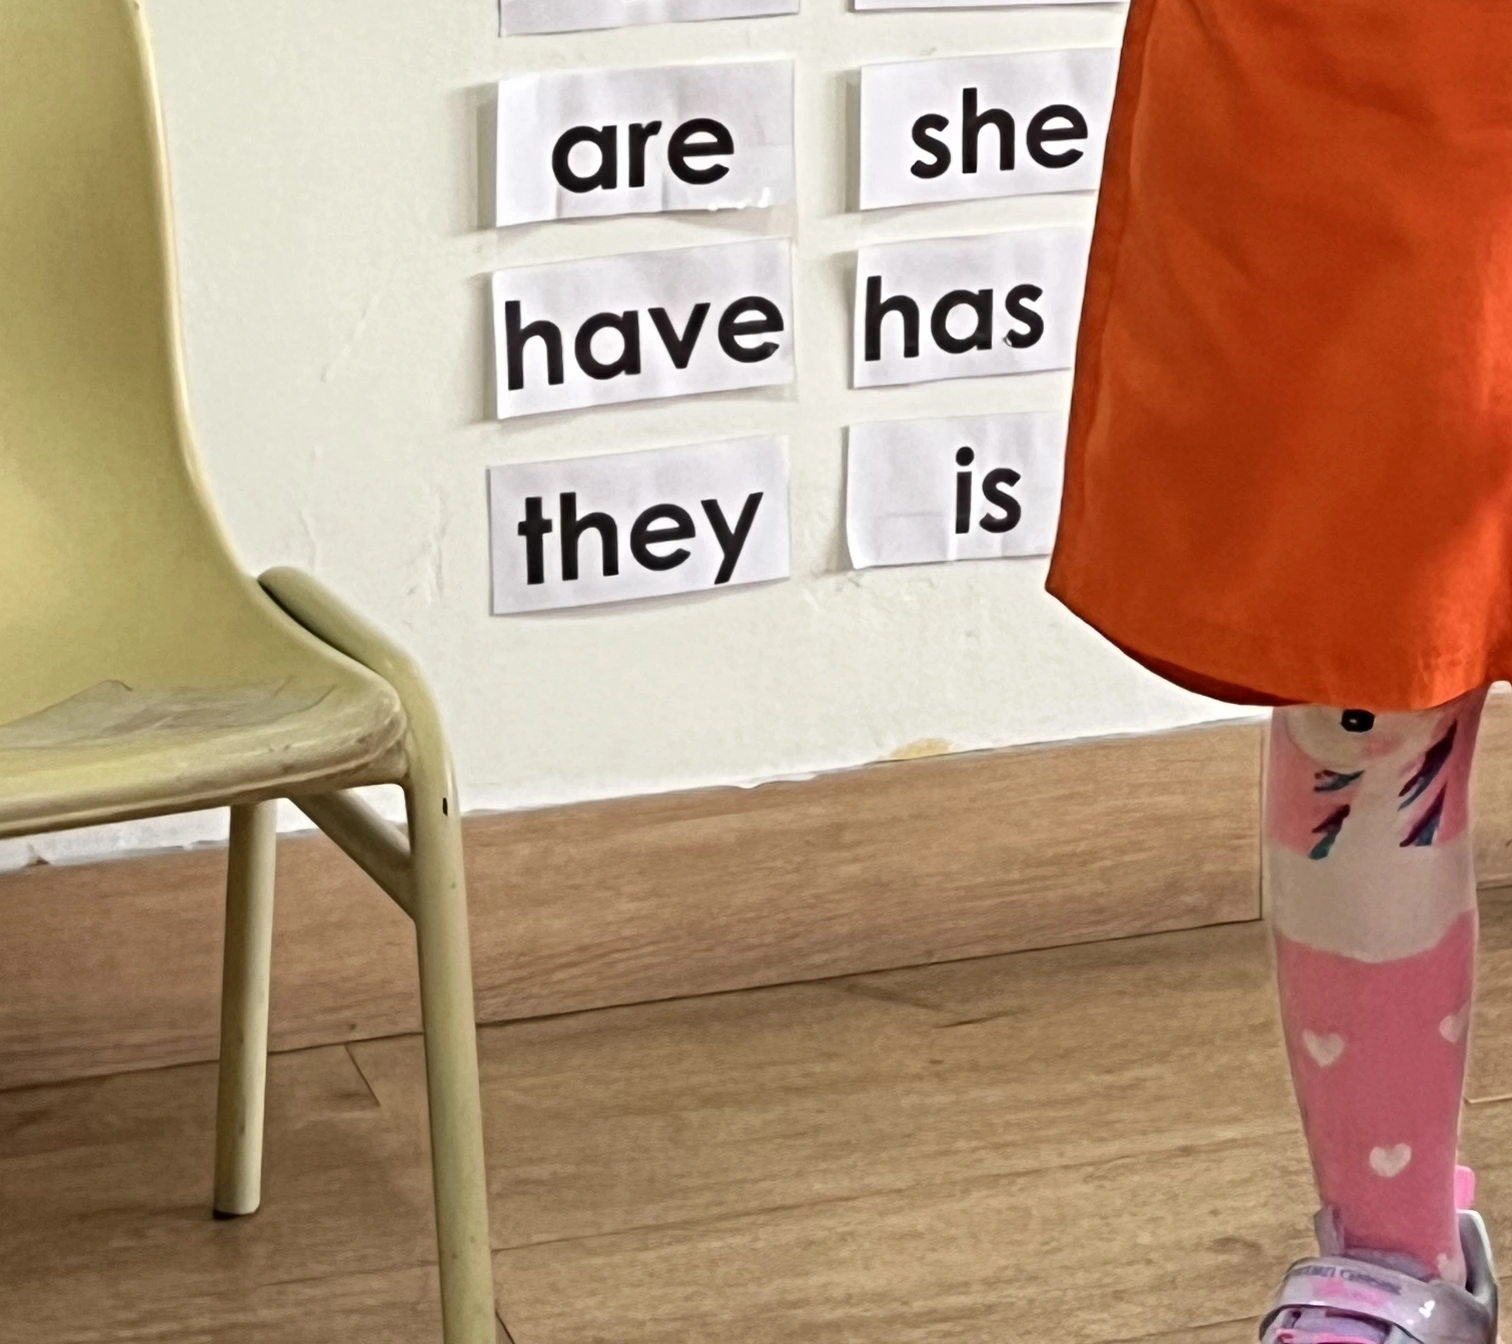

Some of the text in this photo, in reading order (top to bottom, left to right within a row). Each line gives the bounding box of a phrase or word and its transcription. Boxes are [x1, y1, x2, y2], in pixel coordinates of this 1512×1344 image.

[552, 118, 735, 192] are
[910, 88, 1089, 179] she
[505, 295, 784, 390] have
[864, 276, 1044, 361] has
[955, 446, 1022, 534] is
[517, 492, 764, 585] they
